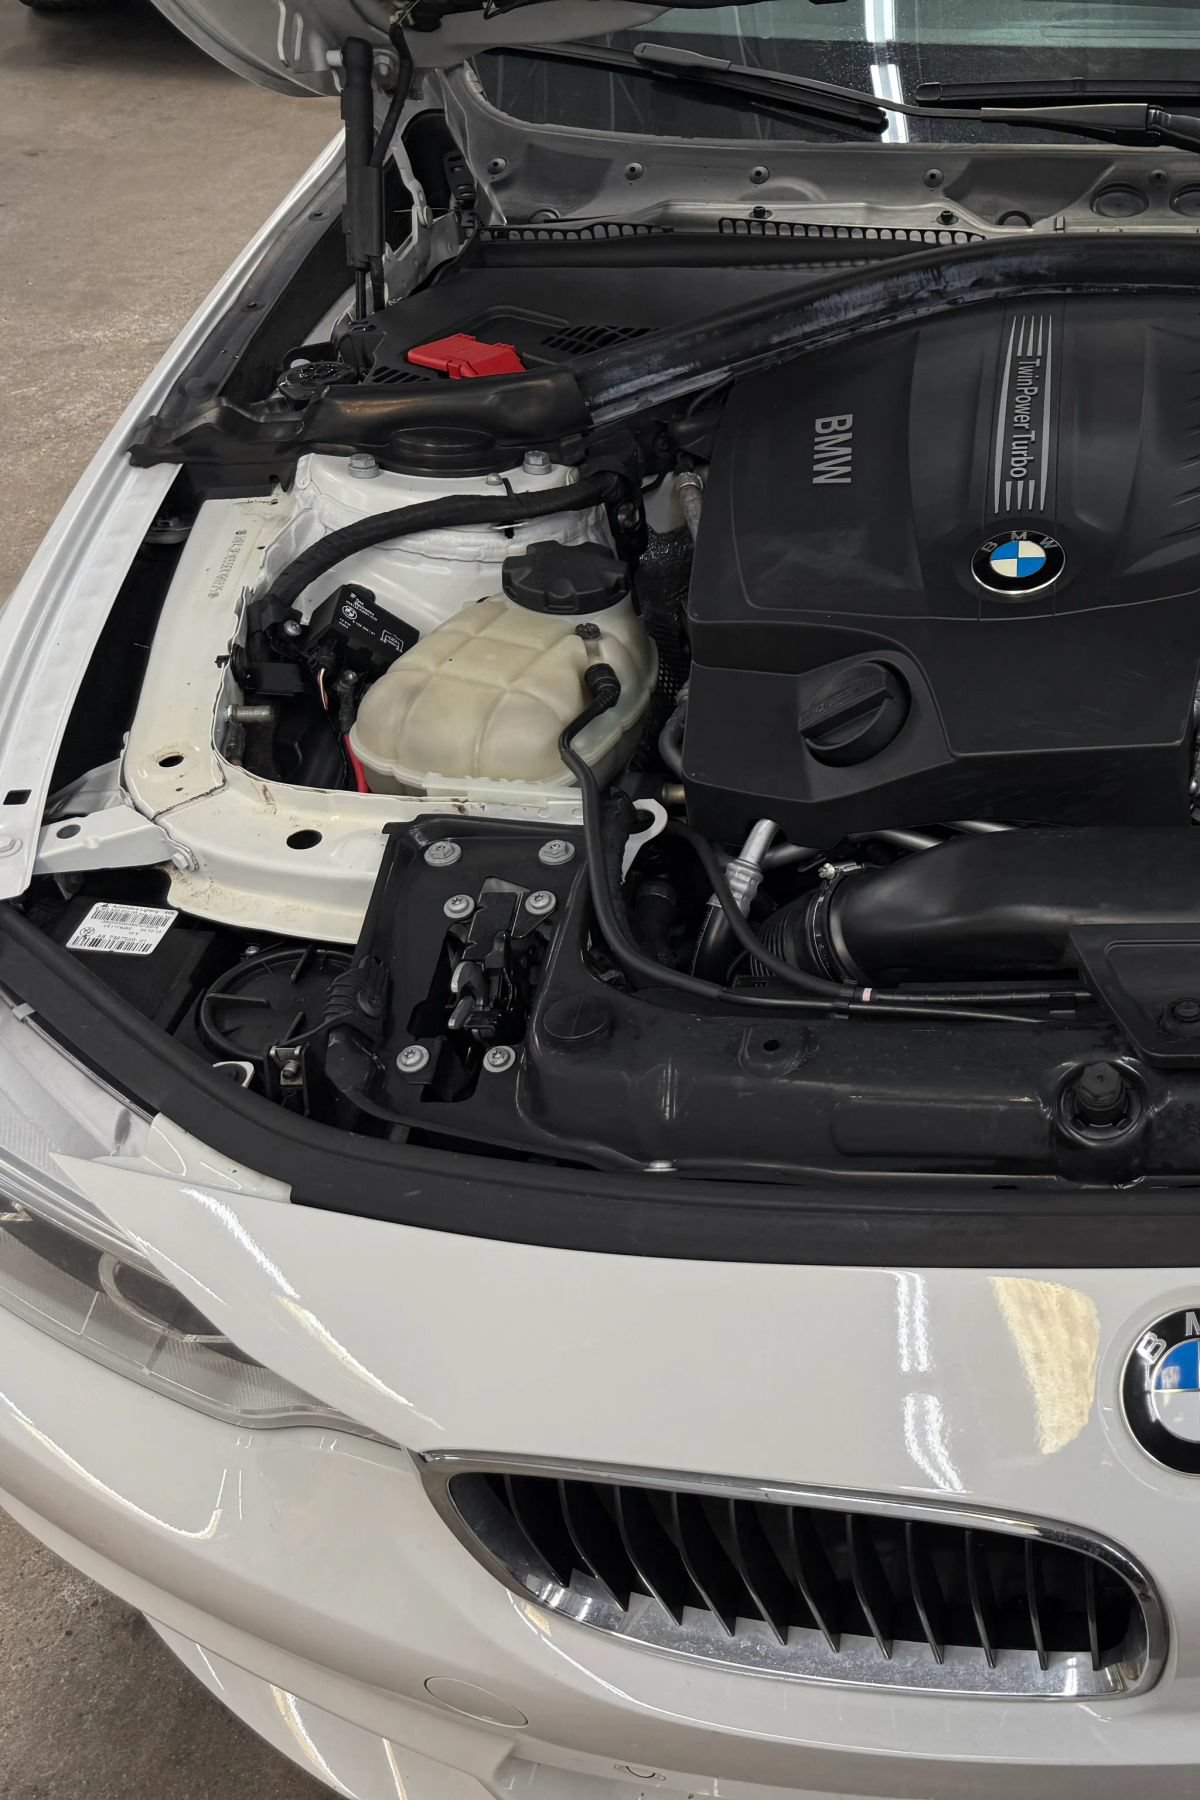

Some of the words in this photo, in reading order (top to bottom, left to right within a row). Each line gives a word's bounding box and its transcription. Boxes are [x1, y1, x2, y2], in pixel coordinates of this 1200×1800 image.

[1013, 358, 1040, 429] TwinPower
[812, 413, 854, 484] BMW
[1010, 430, 1036, 478] Turbo
[981, 531, 1058, 553] BMW
